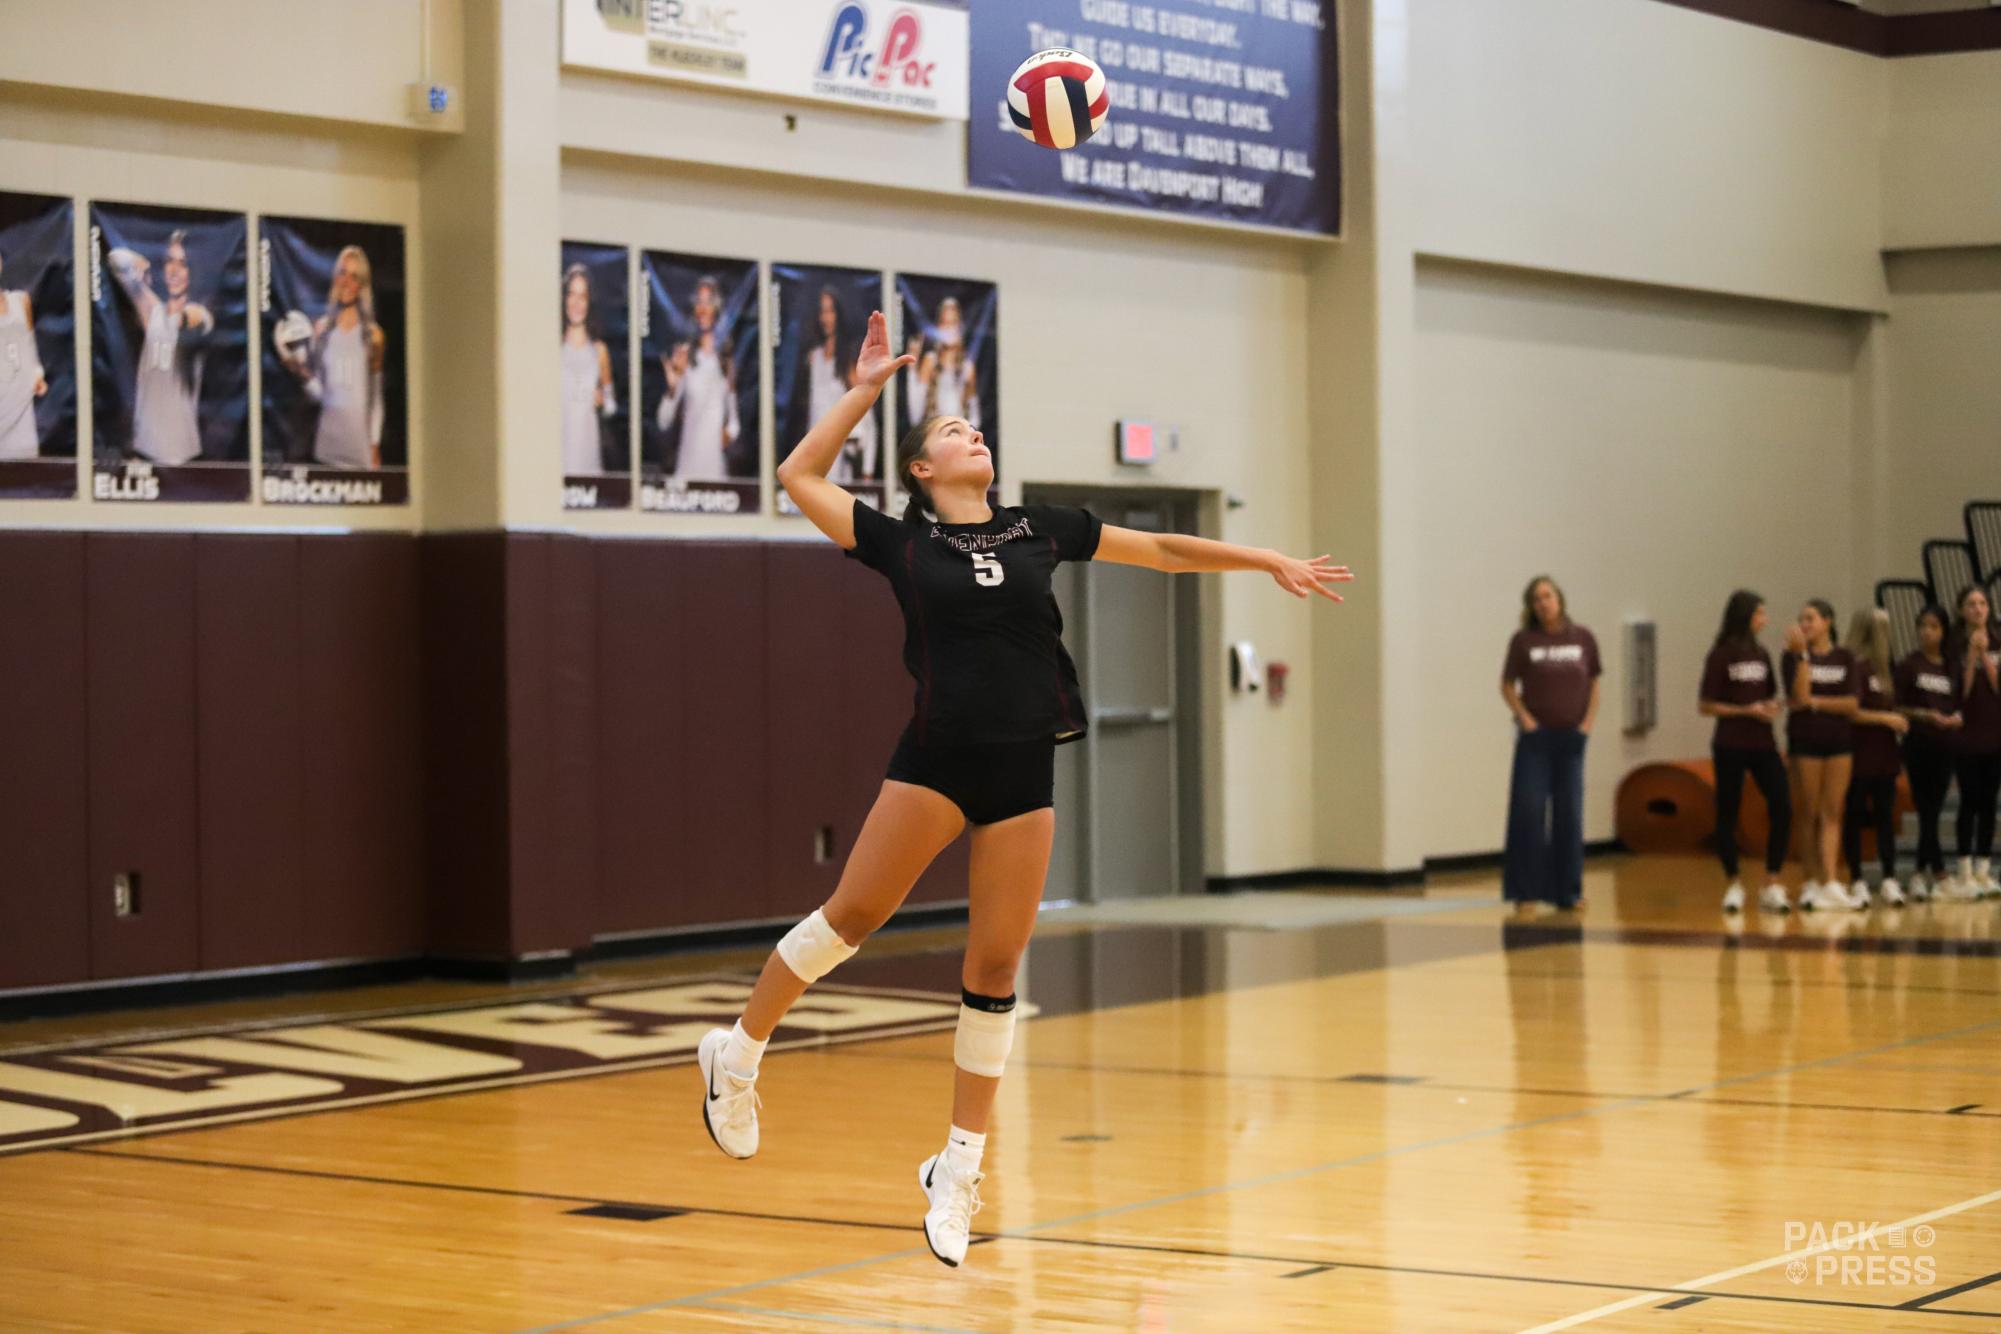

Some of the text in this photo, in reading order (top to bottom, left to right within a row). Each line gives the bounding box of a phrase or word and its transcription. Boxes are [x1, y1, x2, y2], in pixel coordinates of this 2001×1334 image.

[1131, 5, 1155, 32] US
[822, 5, 935, 88] Pic Pac
[1099, 38, 1124, 67] GO
[1125, 43, 1160, 73] OUR
[1162, 50, 1243, 88] SEPARATE
[1159, 90, 1192, 119] ALL
[1192, 95, 1227, 125] OUR
[1113, 122, 1138, 149] UP
[1140, 125, 1181, 157] TALL
[1183, 133, 1237, 165] ABOVE
[1238, 142, 1280, 172] THEM
[94, 473, 159, 499] ELLIS
[971, 552, 1004, 587] 5
